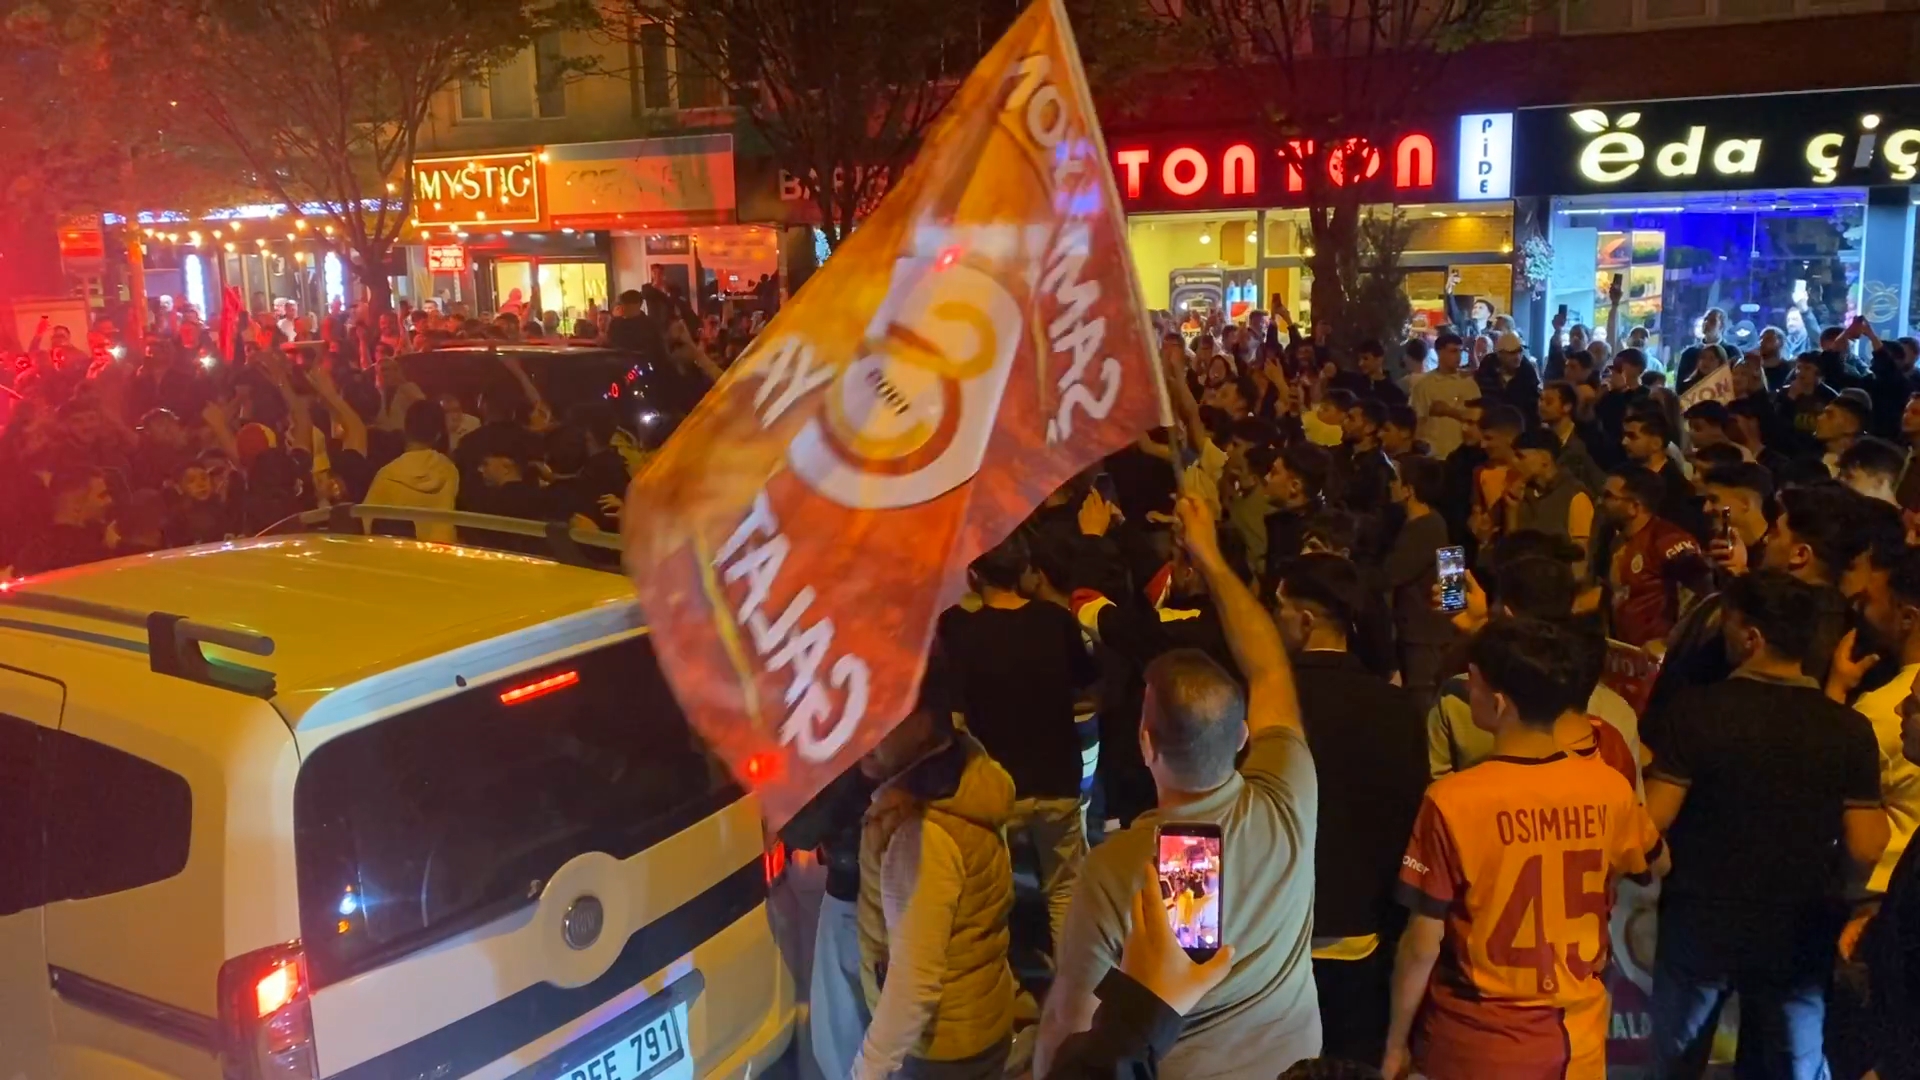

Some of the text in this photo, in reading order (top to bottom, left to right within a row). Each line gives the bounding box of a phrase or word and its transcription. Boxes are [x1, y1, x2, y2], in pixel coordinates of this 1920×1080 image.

[419, 162, 526, 201] MYSTIC
[1486, 848, 1608, 994] 45
[630, 1019, 673, 1073] 791
